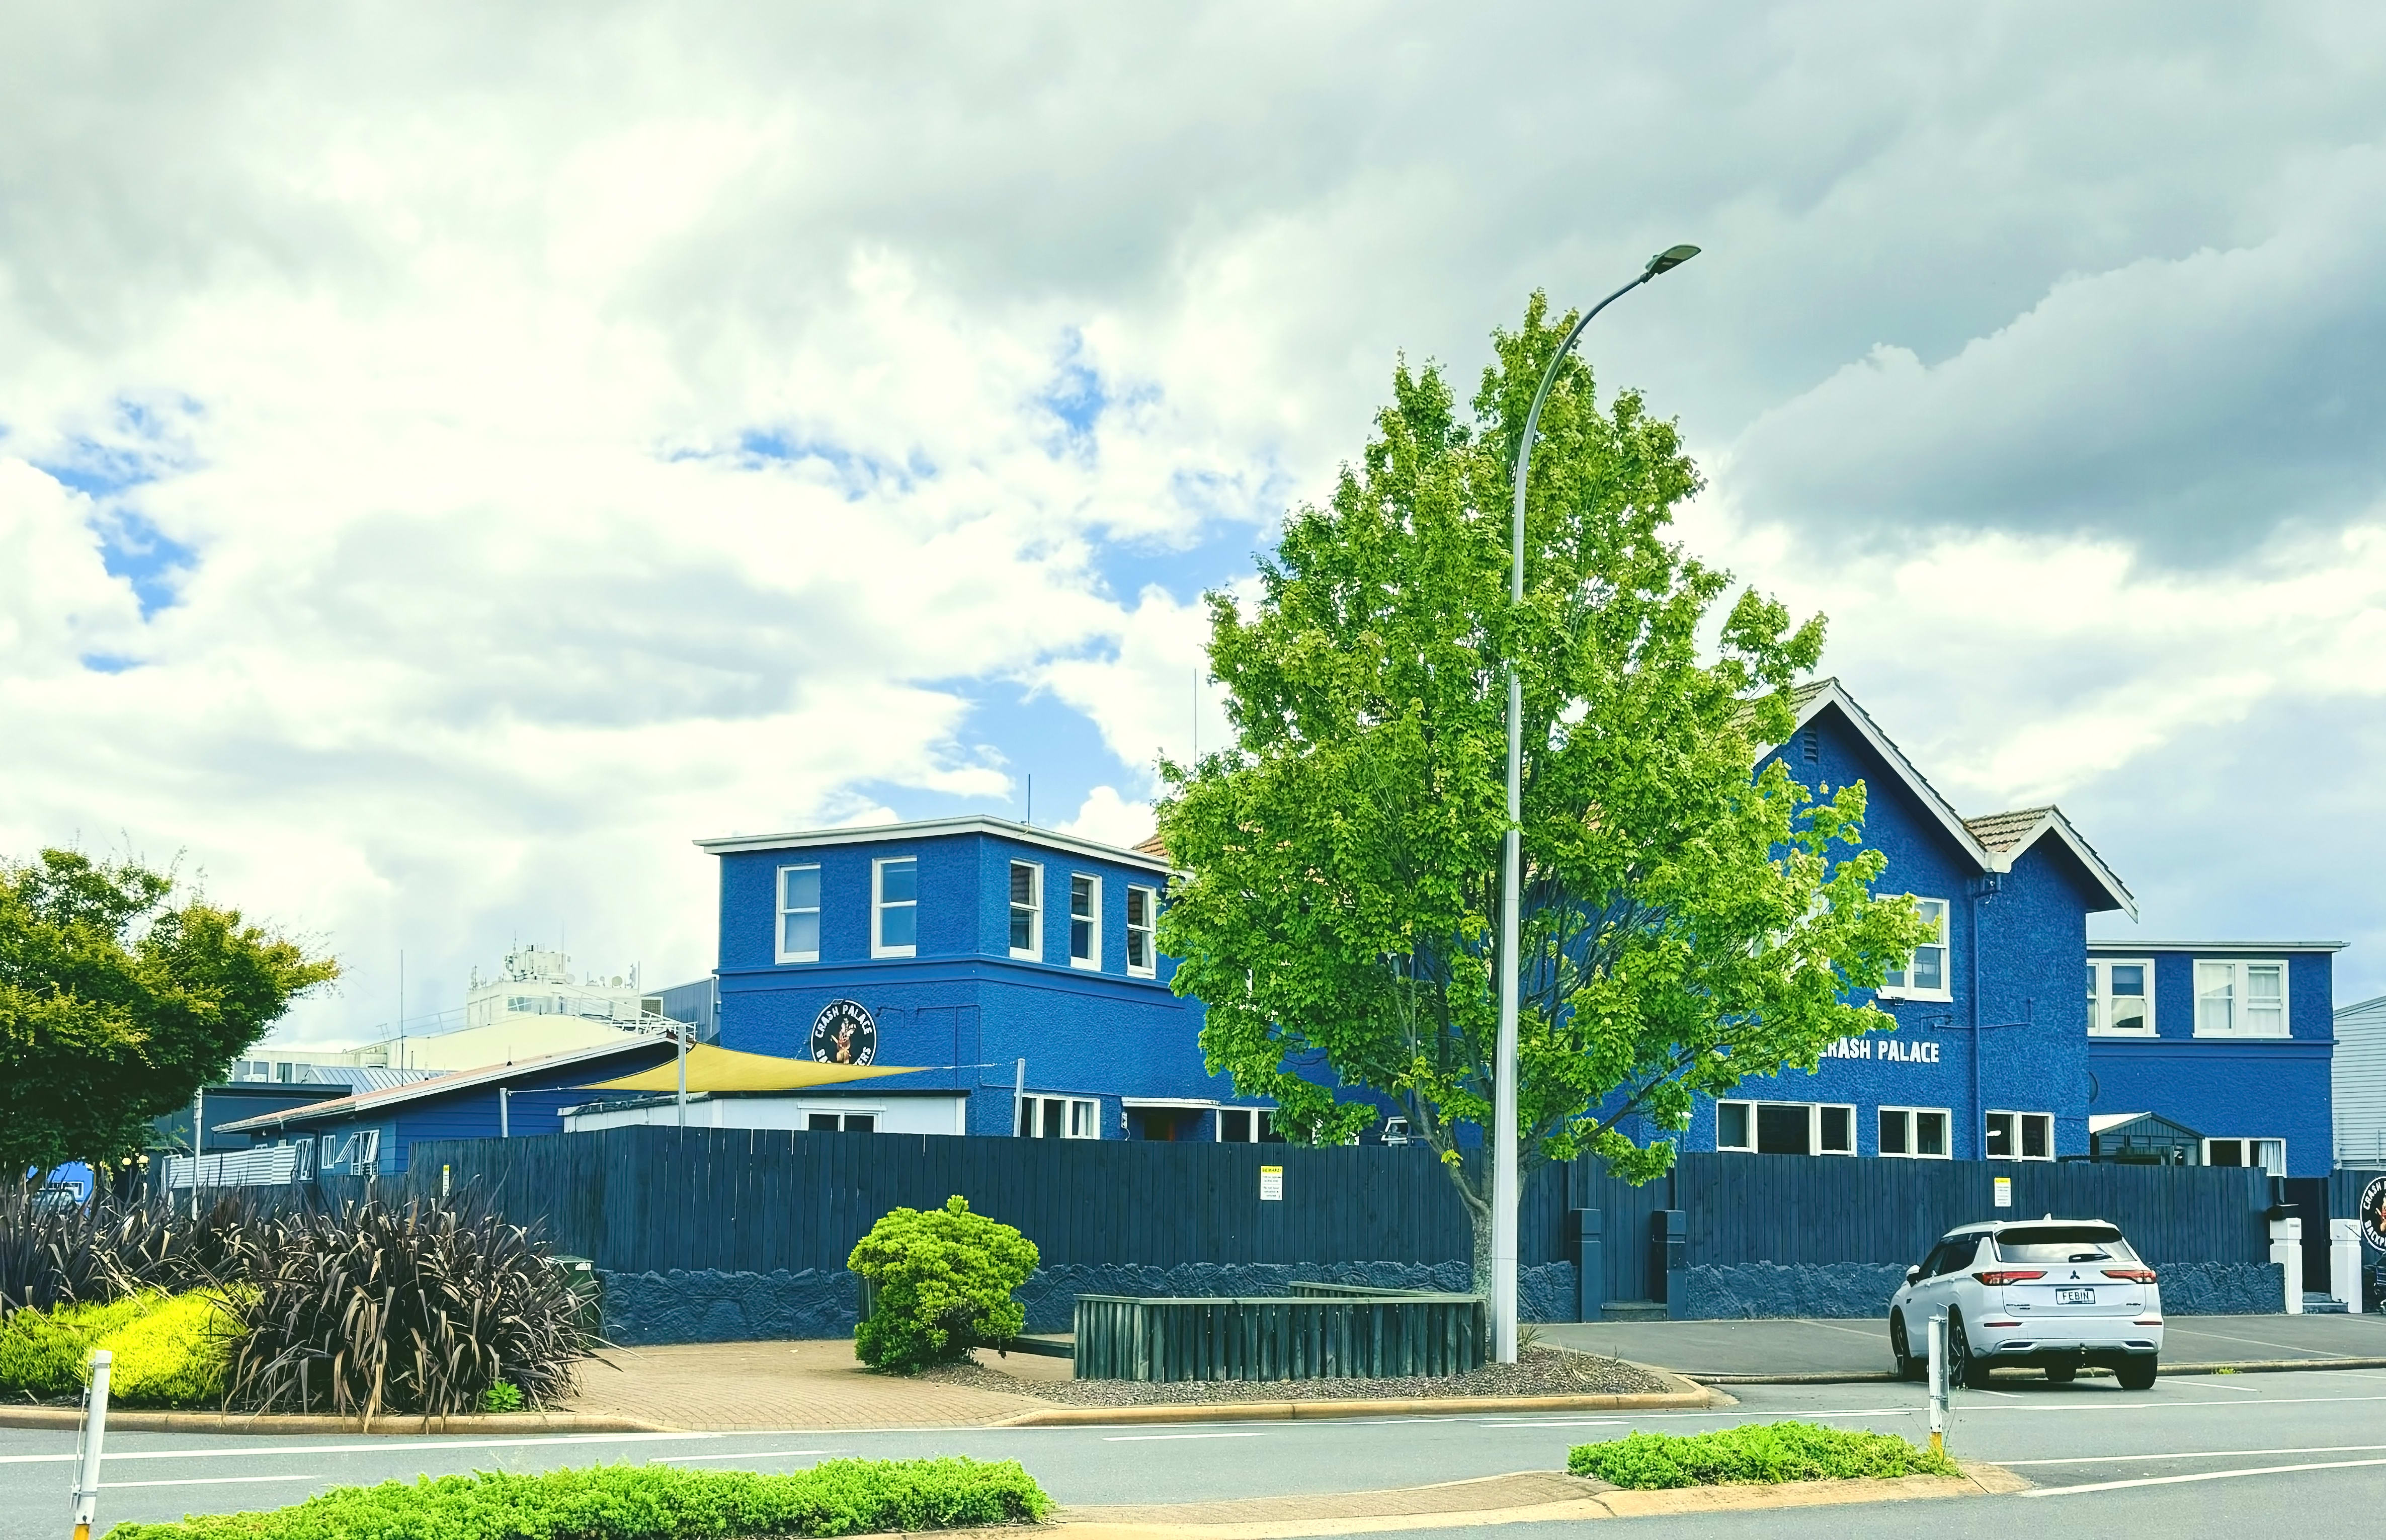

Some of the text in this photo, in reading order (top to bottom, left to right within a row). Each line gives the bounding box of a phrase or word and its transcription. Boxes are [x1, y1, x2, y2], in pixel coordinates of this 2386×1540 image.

[815, 1005, 872, 1038] CRASH PALACE
[1878, 1039, 1939, 1063] PALACE
[2363, 1181, 2382, 1210] CRASH
[2364, 1220, 2386, 1247] BACKP
[2063, 1291, 2089, 1301] FEBIN
